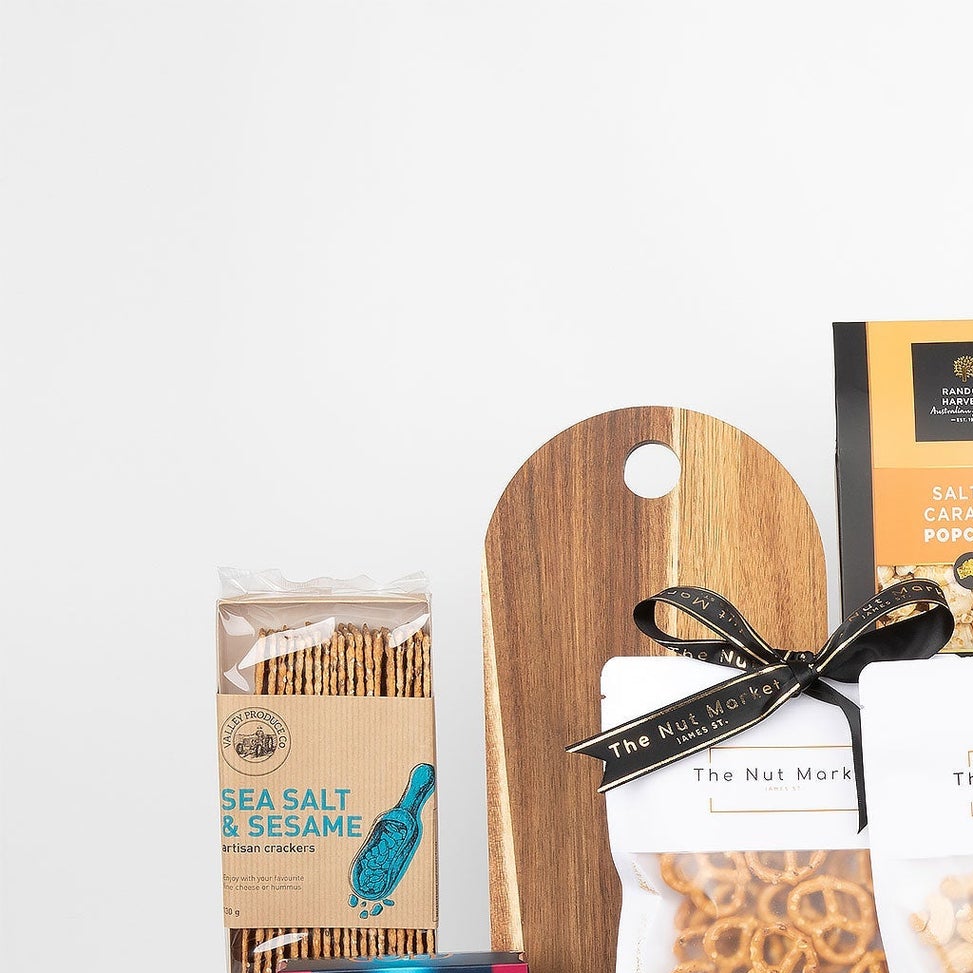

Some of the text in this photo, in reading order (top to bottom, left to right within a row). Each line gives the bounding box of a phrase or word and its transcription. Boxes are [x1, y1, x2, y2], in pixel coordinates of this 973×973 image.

[930, 406, 971, 415] Australian
[608, 679, 781, 758] The Nut Market
[224, 710, 286, 750] VALLEY PRODUCE
[675, 727, 709, 745] JAMES
[693, 766, 852, 783] The Nut Mark
[221, 788, 351, 811] SEA SALT
[222, 815, 363, 837] & SESAME
[222, 842, 316, 853] artisan crackers
[241, 874, 256, 882] with
[257, 875, 273, 883] your
